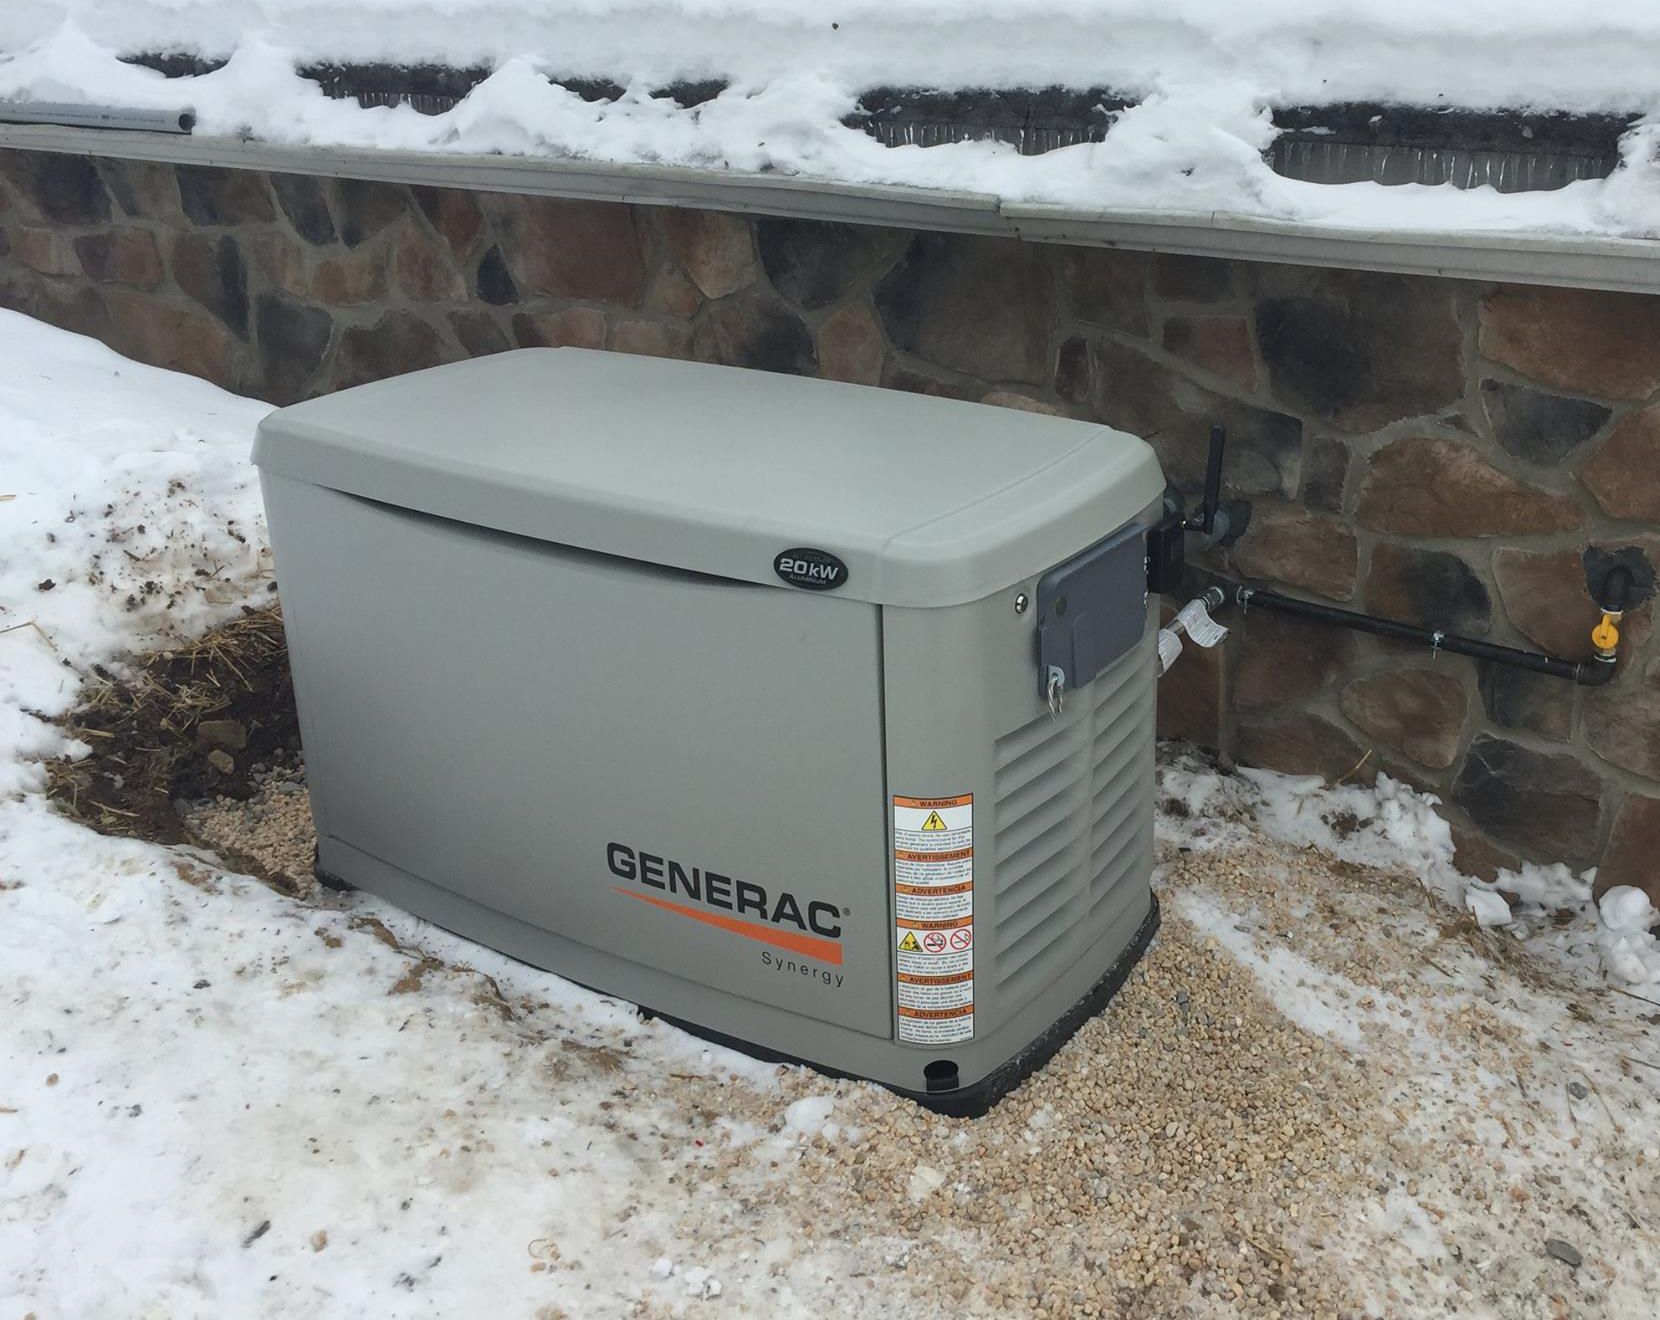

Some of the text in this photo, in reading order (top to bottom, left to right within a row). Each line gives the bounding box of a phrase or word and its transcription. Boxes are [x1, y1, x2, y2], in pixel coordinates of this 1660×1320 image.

[779, 558, 839, 580] 20kW
[919, 799, 958, 807] WARNING
[907, 850, 971, 862] AVERTISSEMENT
[911, 885, 966, 895] ADVERTENCIA
[921, 921, 959, 929] WARNING
[761, 951, 844, 988] Synergy
[909, 974, 972, 985] AVERTISSEMENT
[914, 1008, 967, 1018] ADVERTENCIA
